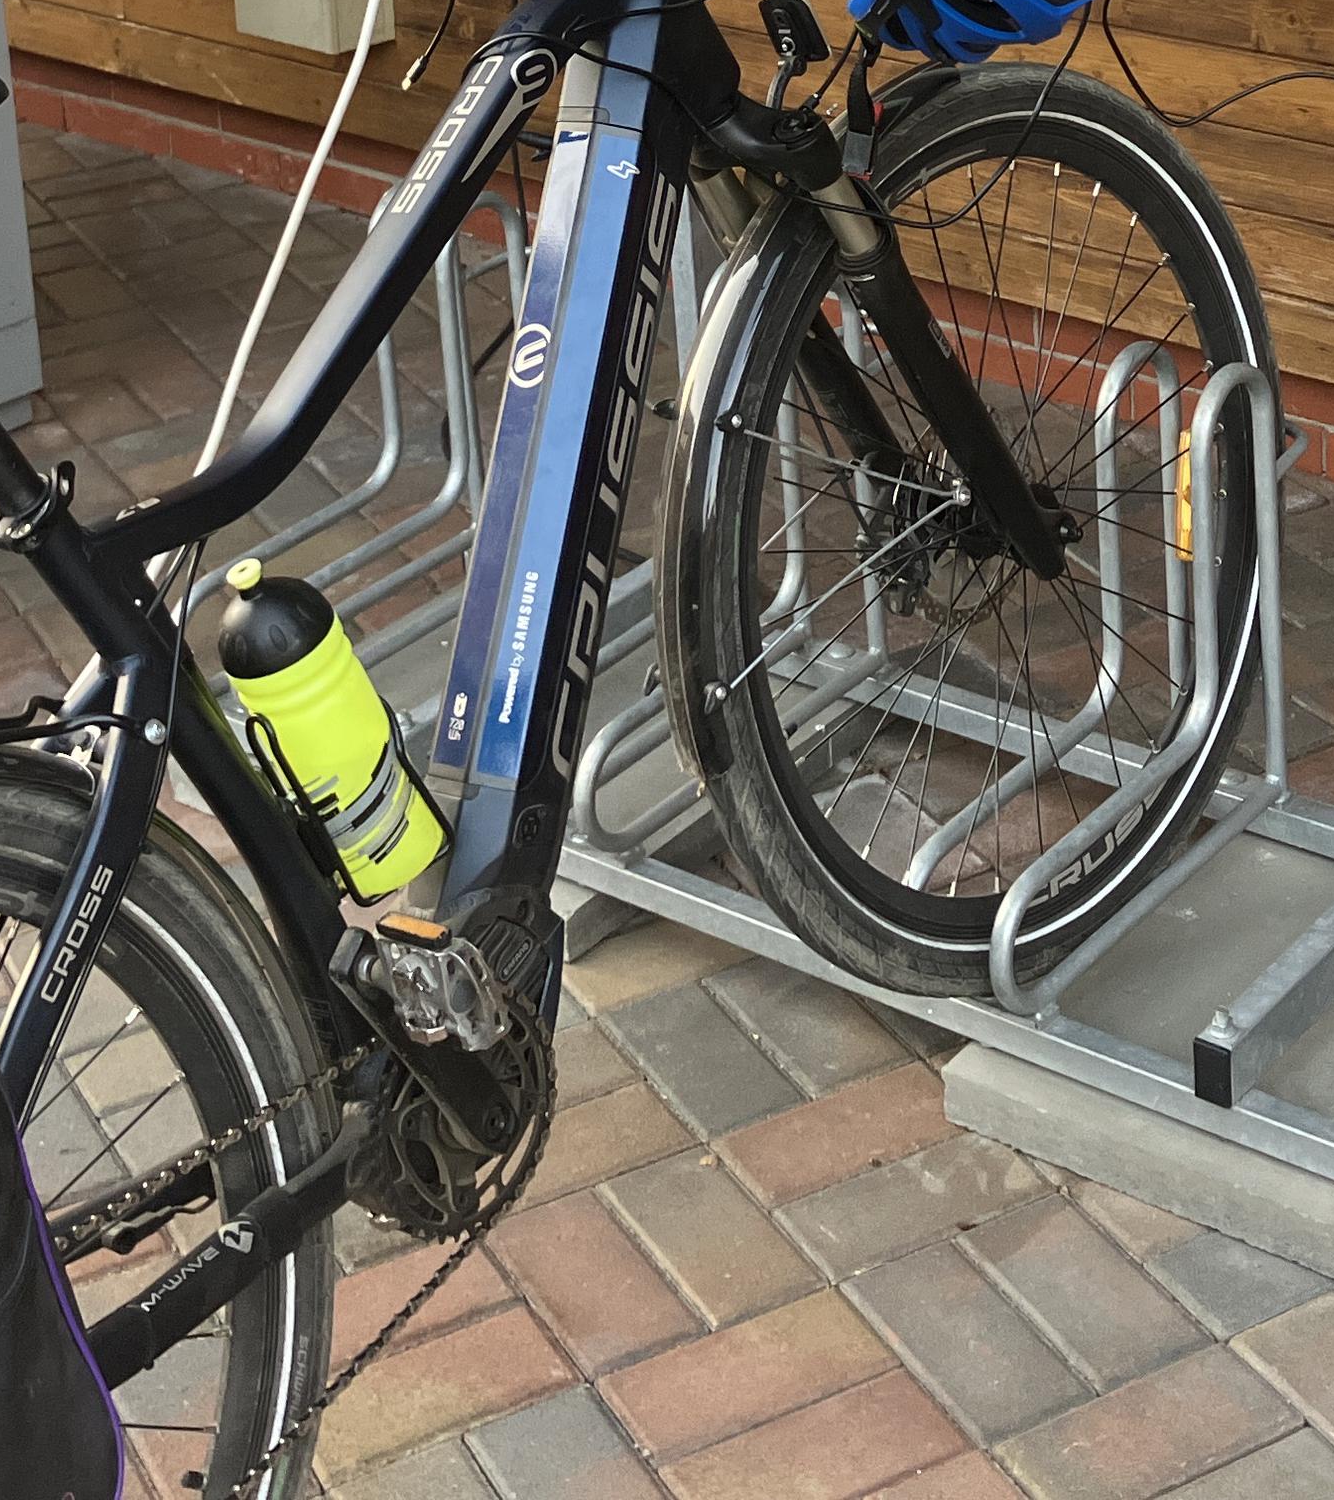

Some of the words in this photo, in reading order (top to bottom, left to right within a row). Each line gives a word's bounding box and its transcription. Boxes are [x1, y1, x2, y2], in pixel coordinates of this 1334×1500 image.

[551, 180, 677, 777] CRUSSIS
[498, 665, 520, 724] Powered
[512, 570, 540, 652] SAMSUNG
[40, 864, 115, 1005] CROSS
